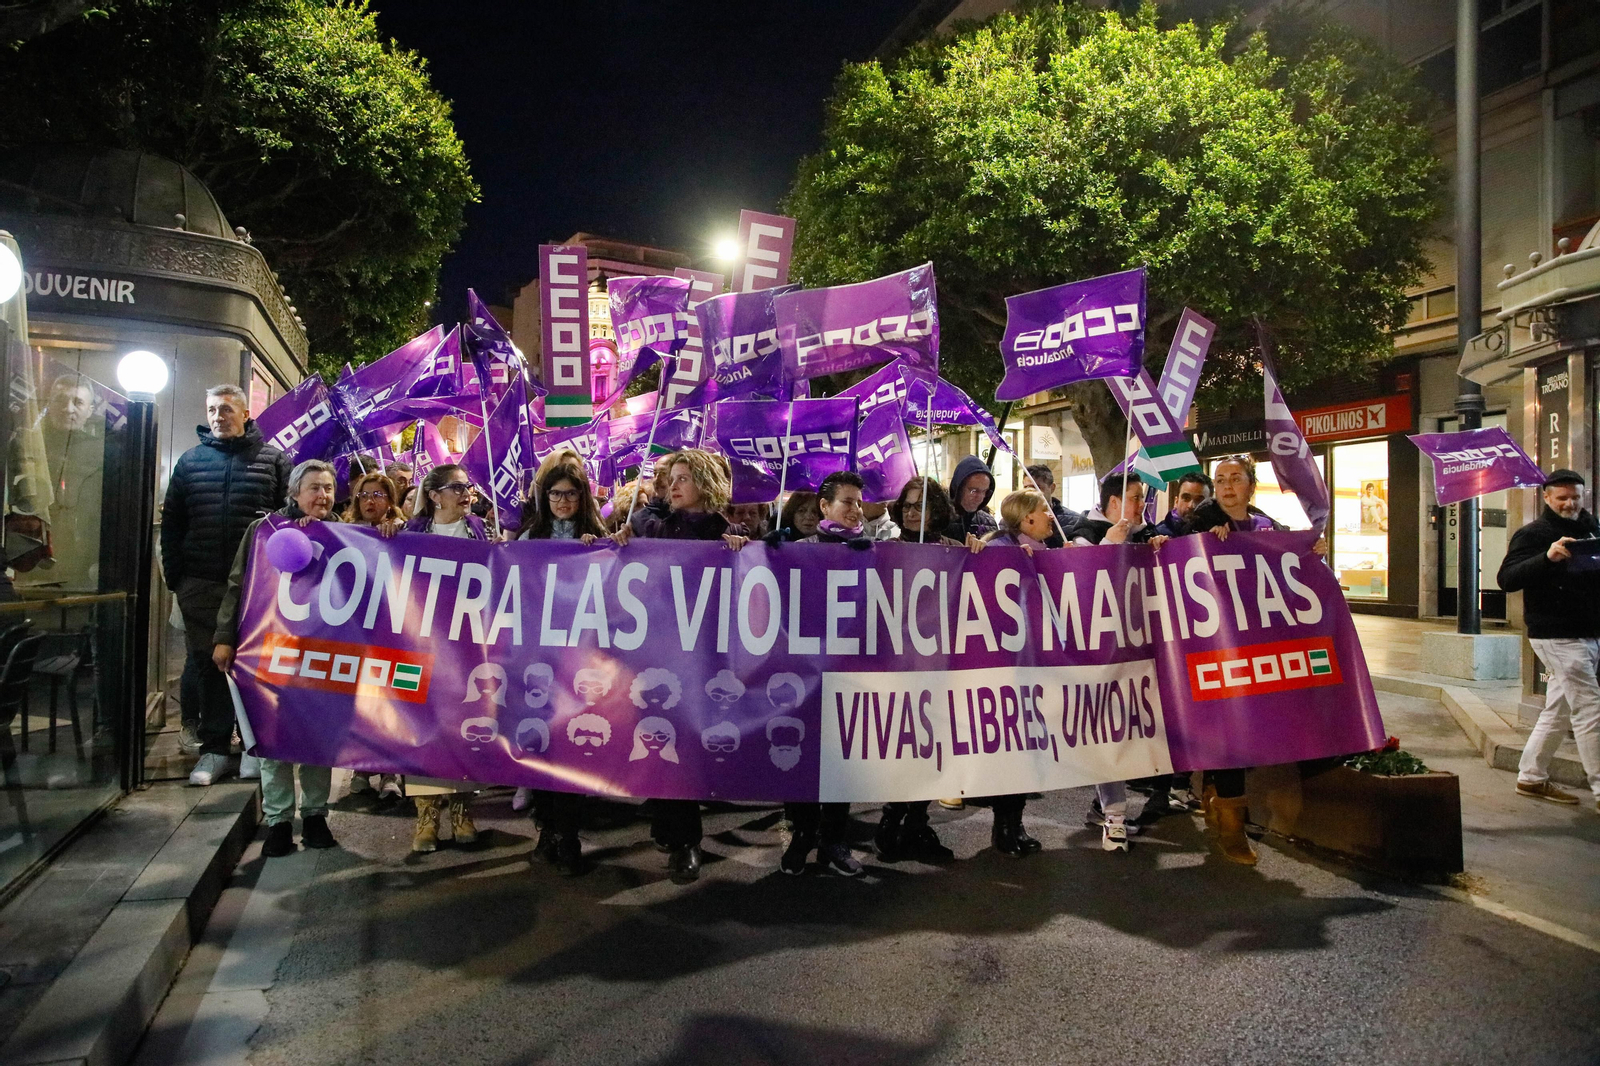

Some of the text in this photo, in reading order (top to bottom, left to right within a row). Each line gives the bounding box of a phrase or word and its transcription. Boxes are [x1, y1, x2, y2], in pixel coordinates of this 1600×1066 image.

[549, 254, 583, 386] CCOO
[1208, 430, 1262, 446] MARTINELLI
[1305, 410, 1364, 436] PIKOLINOS
[1449, 532, 1456, 540] 3
[277, 541, 1323, 656] CONTRA LAS VIOLENCIAS MACHISTAS
[268, 646, 391, 688] CCOO
[1196, 650, 1309, 690] CCOO
[836, 675, 1156, 772] VIVAS, LIBRES, UNIDAS
